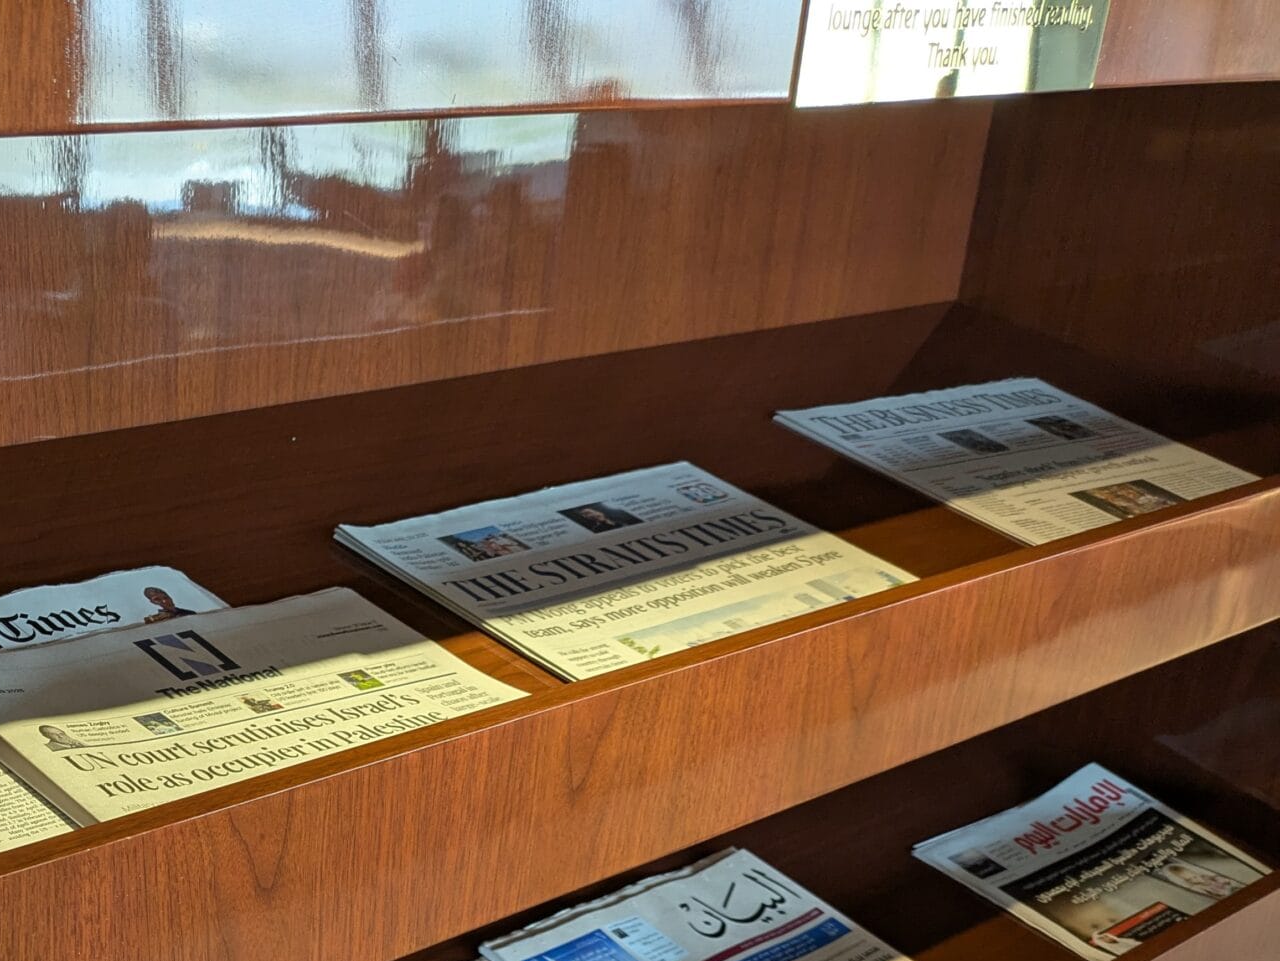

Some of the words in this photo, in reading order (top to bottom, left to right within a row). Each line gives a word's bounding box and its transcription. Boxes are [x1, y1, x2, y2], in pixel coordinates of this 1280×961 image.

[828, 3, 881, 38] lounge
[884, 4, 920, 31] after
[923, 7, 948, 34] you
[955, 4, 985, 28] have
[991, 0, 1042, 27] finished
[928, 41, 967, 68] Thank
[442, 569, 545, 602] THE
[528, 535, 690, 583] STRAITS
[669, 511, 786, 547] TIMES
[580, 586, 640, 614] appeals
[639, 580, 659, 597] to
[659, 566, 702, 594] voters
[702, 563, 720, 580] to
[718, 553, 750, 574] pick
[745, 550, 773, 563] the
[770, 543, 803, 557] best
[524, 622, 572, 639] team,
[570, 614, 607, 633] says
[605, 602, 645, 621] more
[646, 584, 726, 610] opposition
[723, 572, 752, 589] will
[750, 560, 800, 581] weaken
[797, 550, 843, 568] S'pore
[156, 680, 209, 700] The
[207, 666, 283, 691] National
[62, 751, 118, 773] UN
[119, 741, 199, 768] court
[194, 716, 330, 755] scrutinises
[330, 692, 421, 724] Israel's
[96, 774, 162, 798] role
[163, 771, 195, 788] as
[192, 744, 304, 781] occupier
[303, 738, 330, 756] in
[329, 709, 449, 750] Palestine
[1051, 779, 1127, 833] الإمارات
[1016, 821, 1060, 854] اليوم
